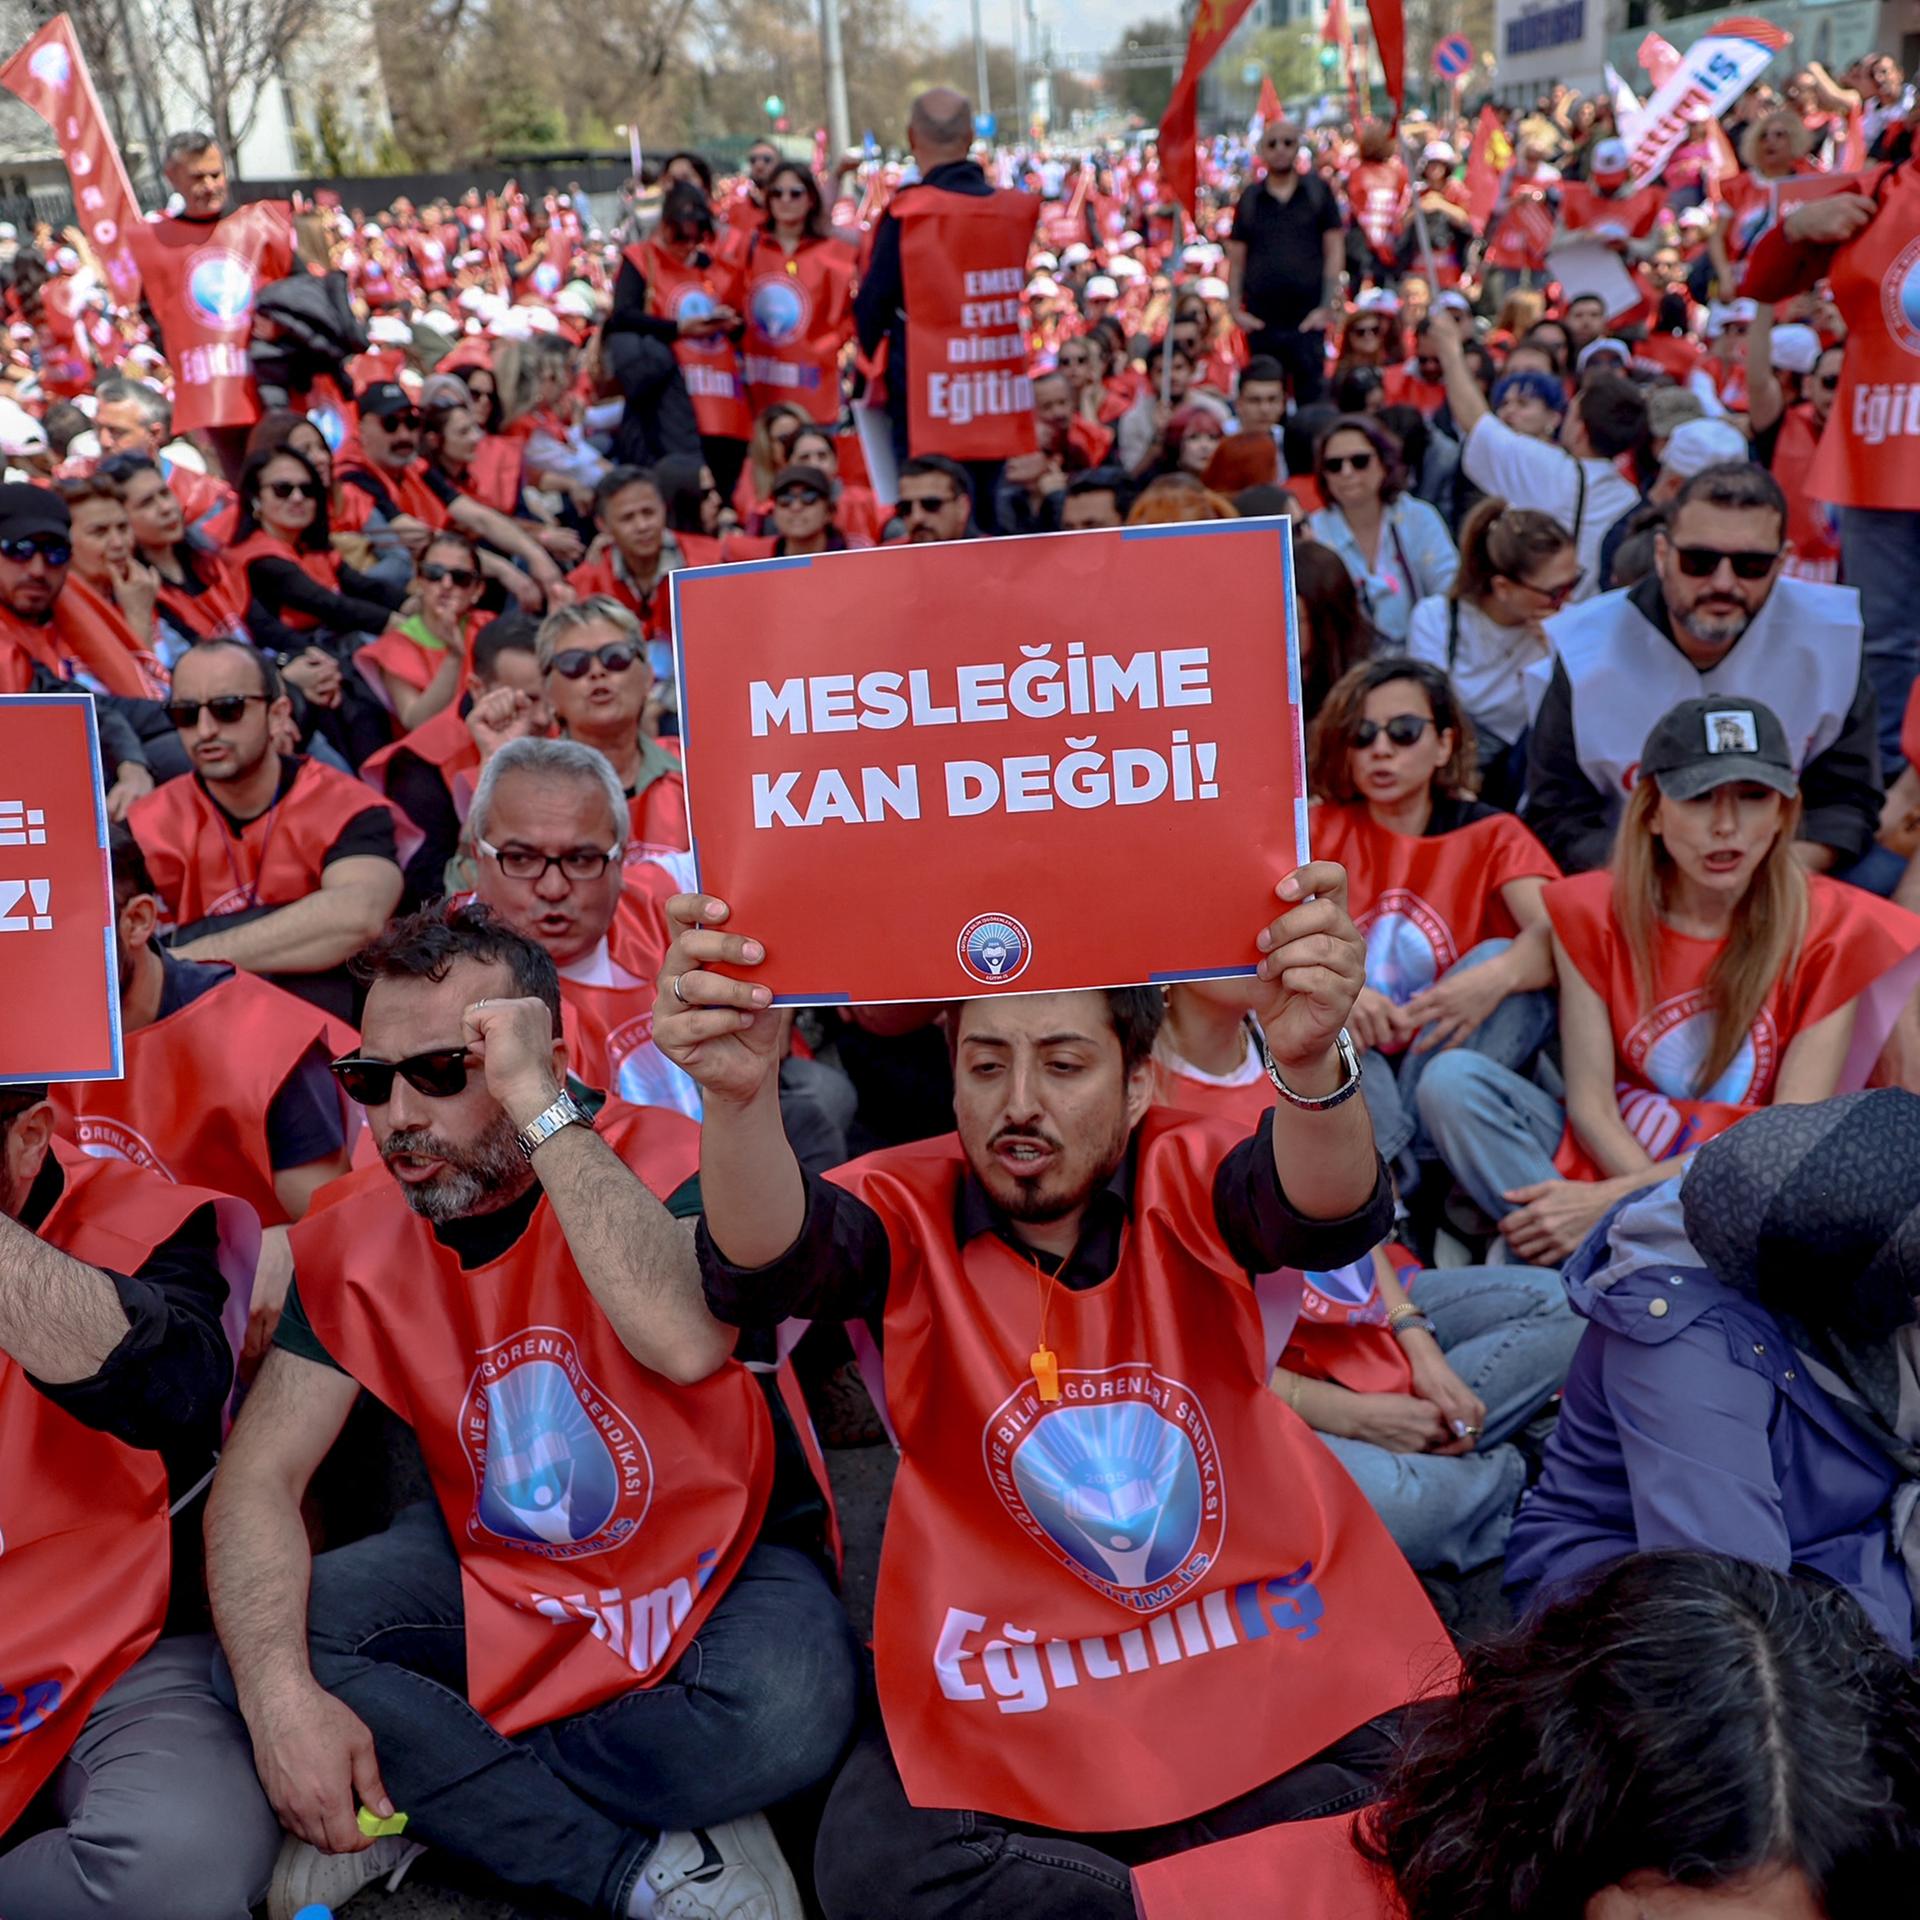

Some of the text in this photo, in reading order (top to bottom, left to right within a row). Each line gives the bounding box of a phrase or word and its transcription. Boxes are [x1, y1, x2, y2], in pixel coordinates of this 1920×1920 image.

[961, 298, 1020, 328] EYLE
[749, 641, 1212, 737] MESLEĞİME
[752, 729, 1219, 829] KAN DEĞDİ!
[580, 1387, 640, 1497] SENDİKASI
[992, 1441, 1007, 1466] VE
[1175, 1401, 1219, 1521] SENDİKASI
